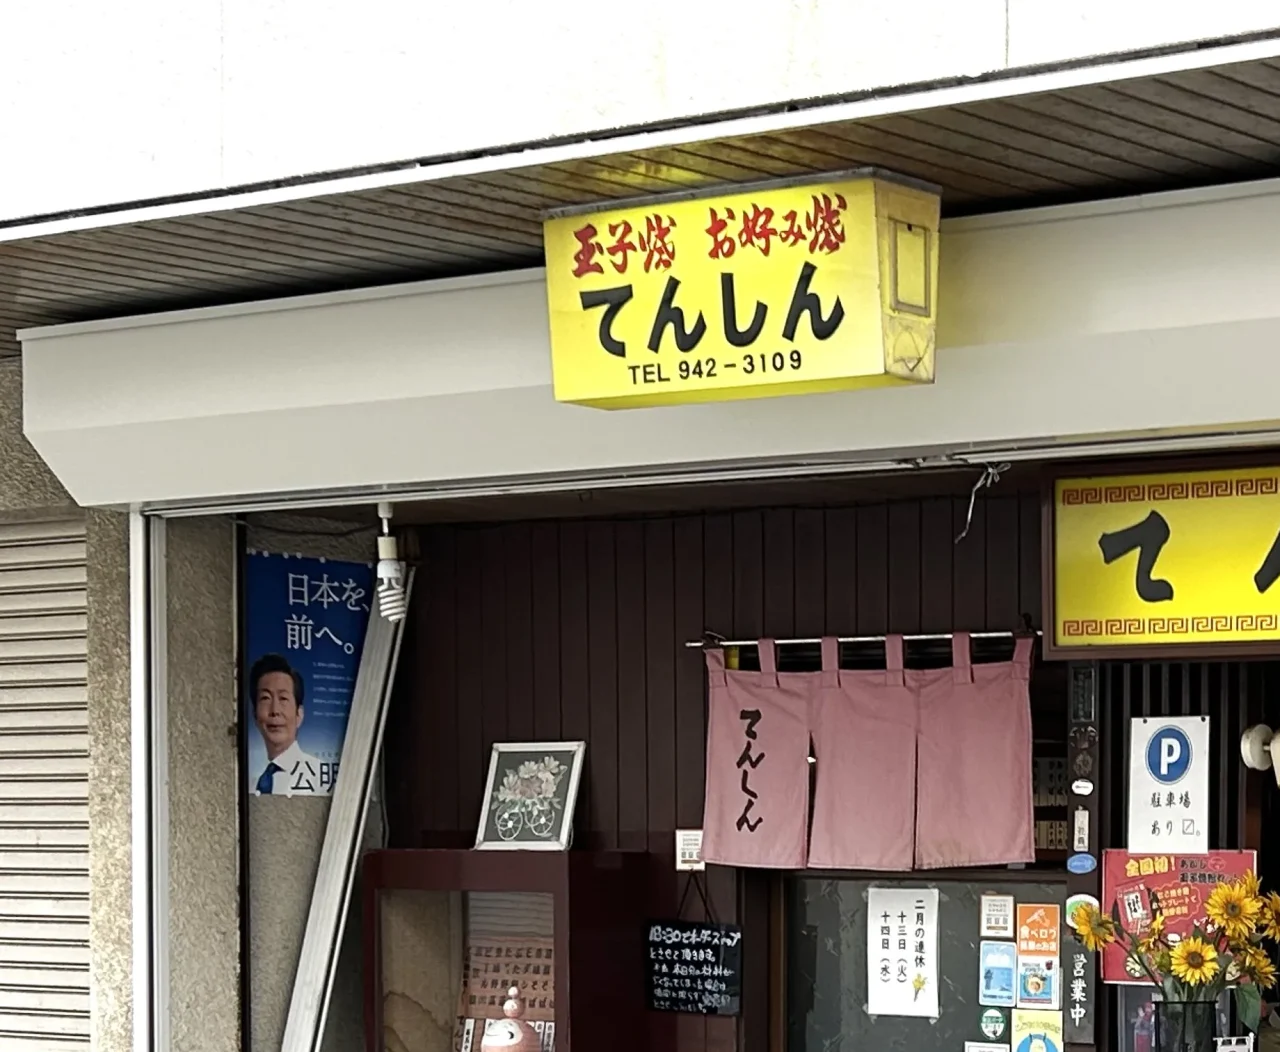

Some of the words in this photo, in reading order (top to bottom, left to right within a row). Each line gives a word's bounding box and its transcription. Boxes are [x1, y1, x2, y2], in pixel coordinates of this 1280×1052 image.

[572, 213, 677, 279] 玉子焼
[705, 193, 848, 260] お好み焼
[579, 261, 845, 358] てんしん
[628, 362, 671, 385] TEL
[287, 573, 370, 612] 日本を、
[284, 614, 354, 654] 前へ。
[735, 709, 765, 832] てんしん
[1160, 738, 1181, 775] P
[1150, 791, 1192, 809] 駐車場
[914, 899, 926, 968] 二月の連休
[1070, 953, 1088, 1027] 営業中
